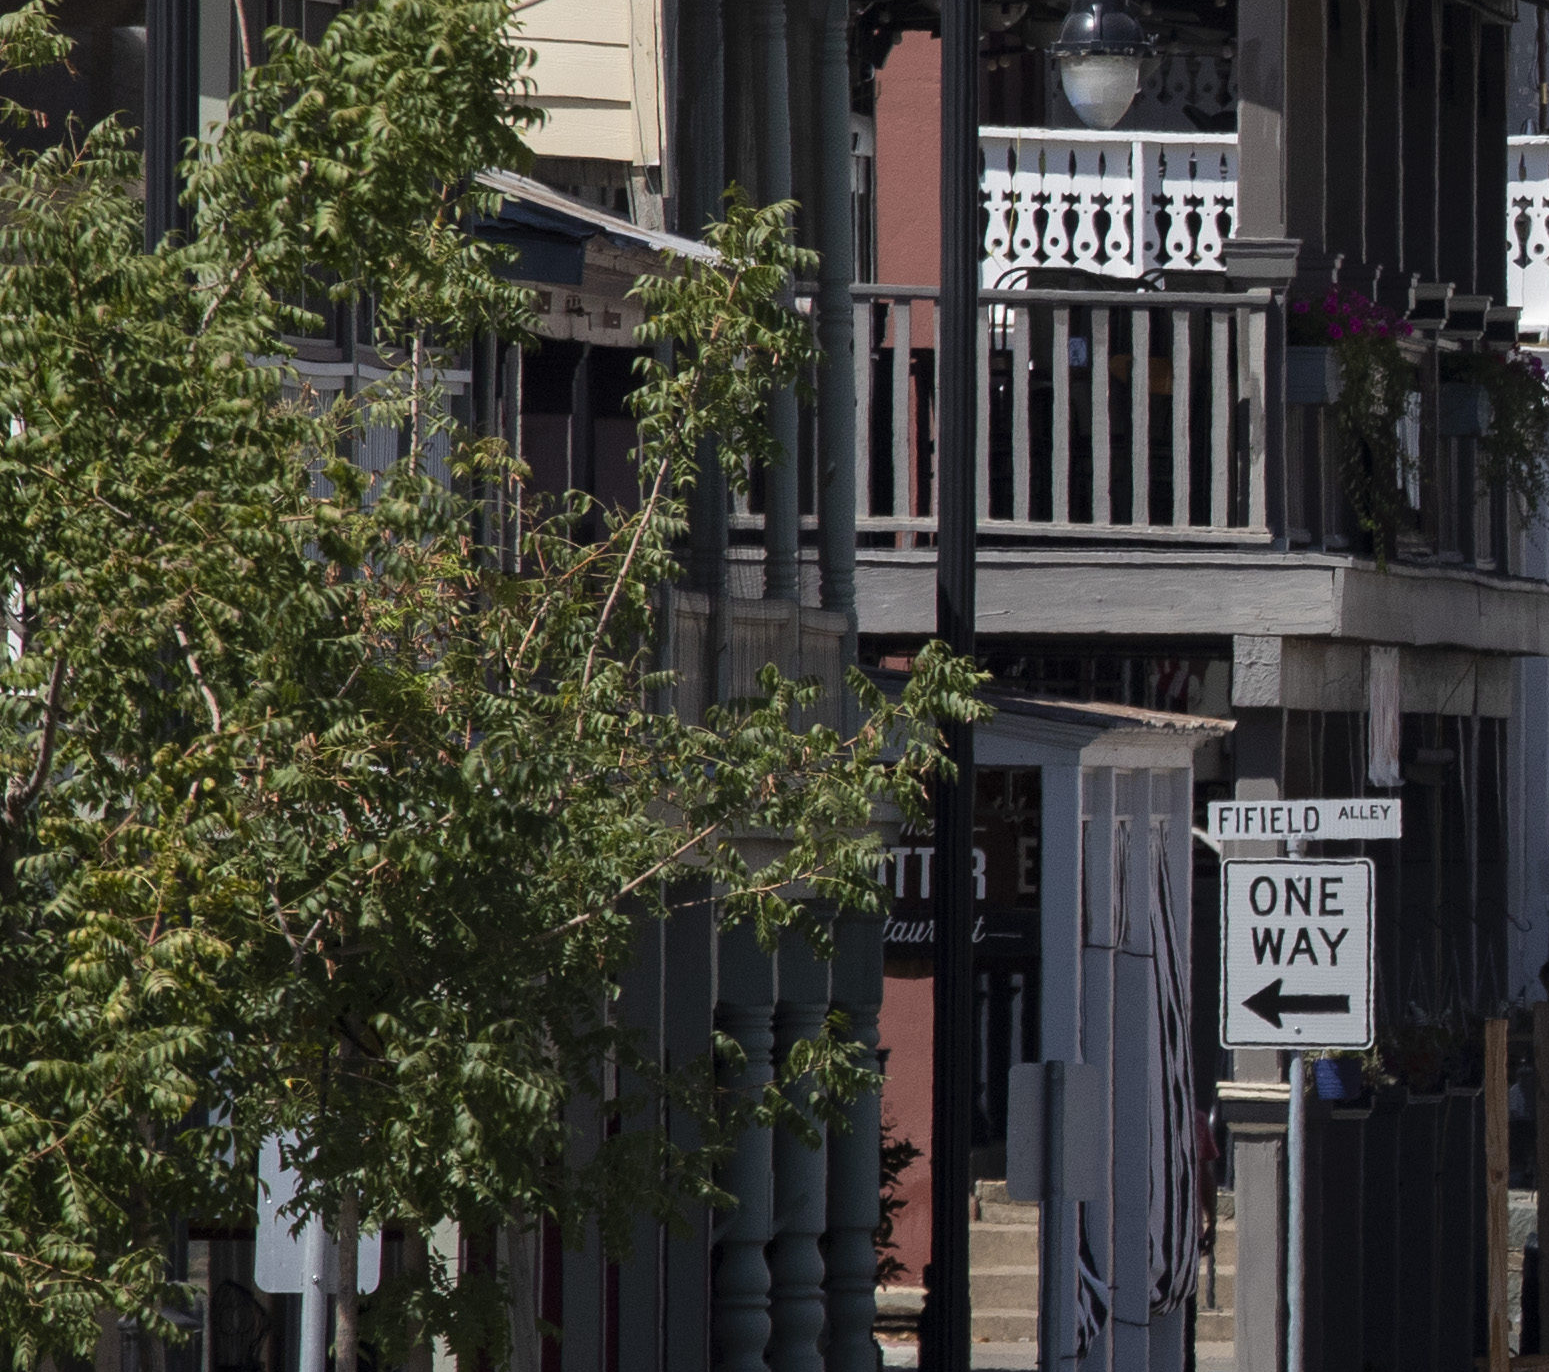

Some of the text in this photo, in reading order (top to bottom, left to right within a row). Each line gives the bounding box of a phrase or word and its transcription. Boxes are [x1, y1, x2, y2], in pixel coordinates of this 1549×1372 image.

[1217, 805, 1391, 835] FIFIELD ALLEY
[1249, 875, 1345, 917] ONE
[1251, 927, 1349, 966] WAY
